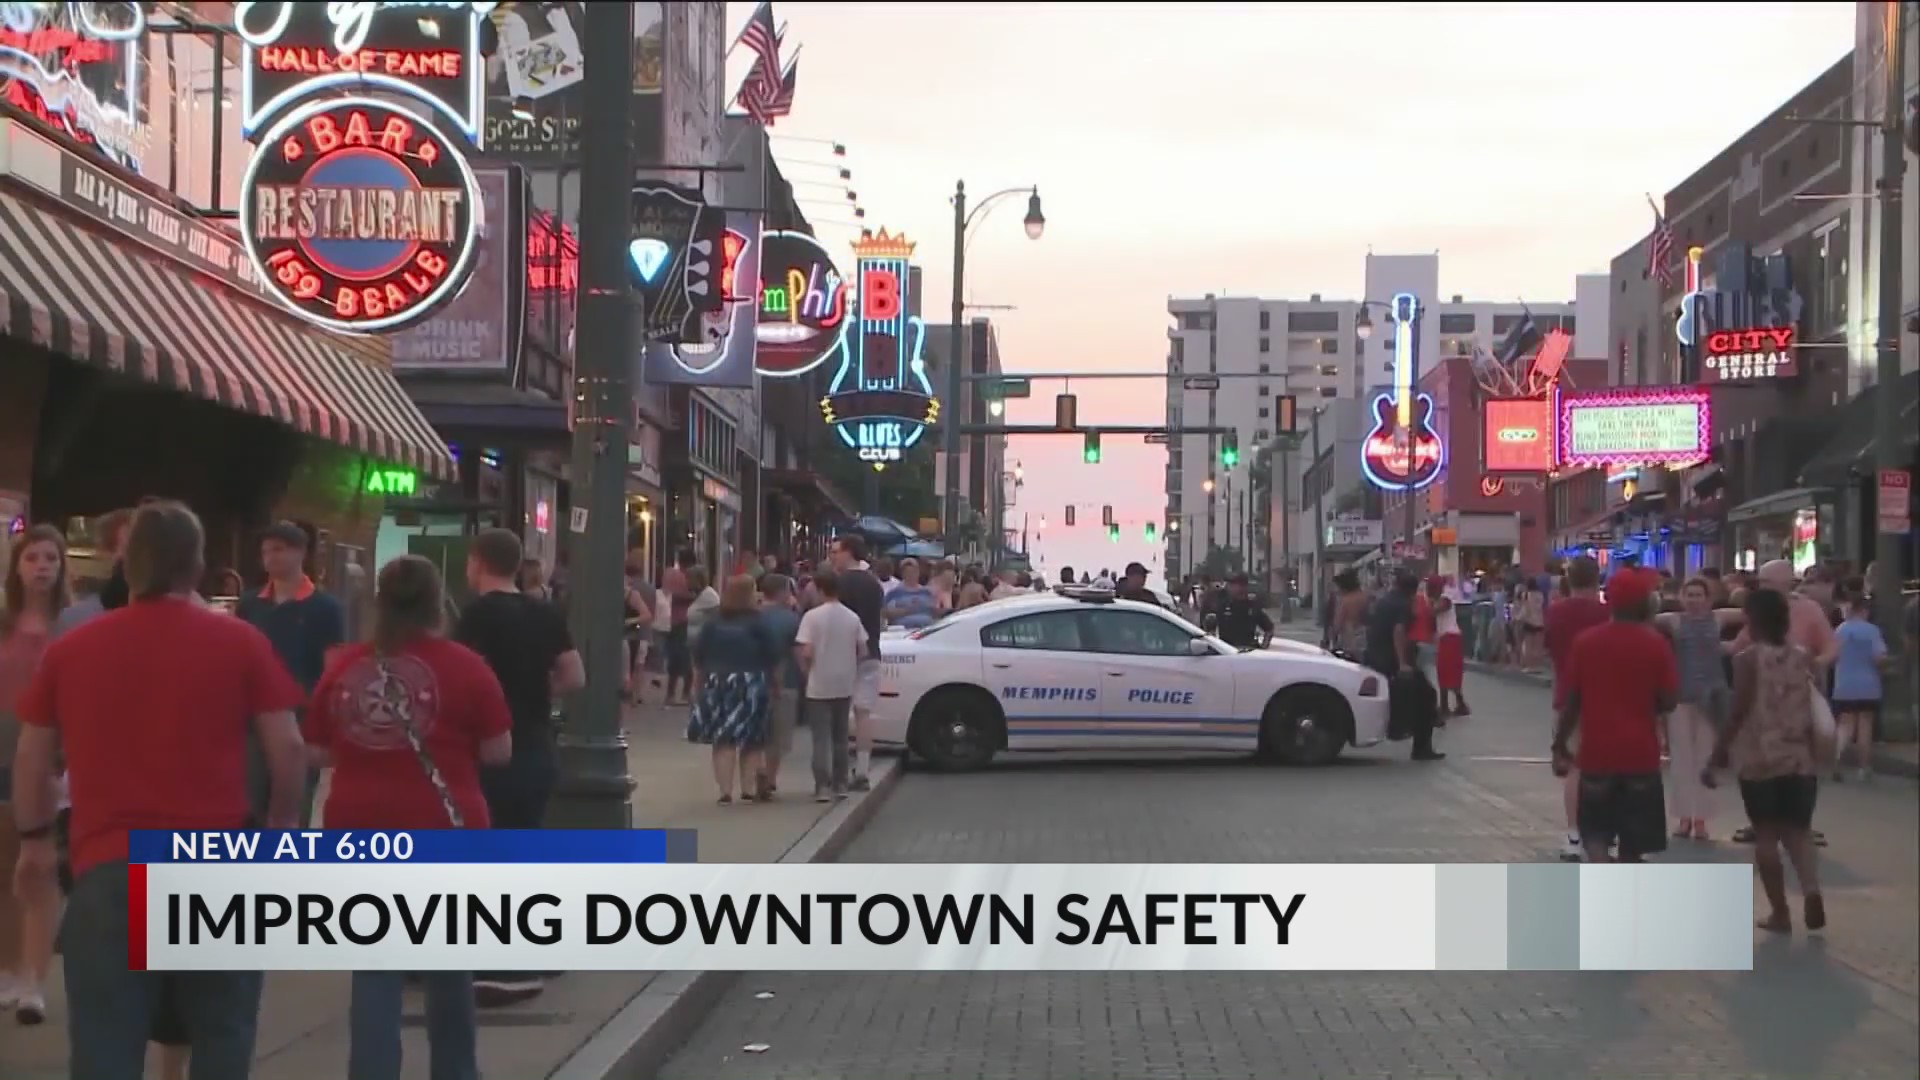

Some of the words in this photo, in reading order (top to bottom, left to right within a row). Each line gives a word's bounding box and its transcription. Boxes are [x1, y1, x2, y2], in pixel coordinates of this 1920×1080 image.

[261, 47, 333, 71] HALL
[337, 50, 377, 72] OF
[385, 51, 461, 76] FAME
[308, 112, 412, 153] BAR
[256, 185, 463, 242] RESTAURANT
[265, 248, 322, 298] 159
[335, 250, 447, 317] BEALE
[863, 271, 899, 320] B
[414, 340, 481, 358] MUSIC
[1708, 329, 1792, 353] CITY
[1706, 351, 1790, 368] GENERAL
[1720, 365, 1776, 380] STORE
[368, 471, 415, 493] ATM
[1885, 475, 1904, 484] NO
[1002, 686, 1097, 700] MEMPHIS
[1127, 688, 1195, 705] POLICE
